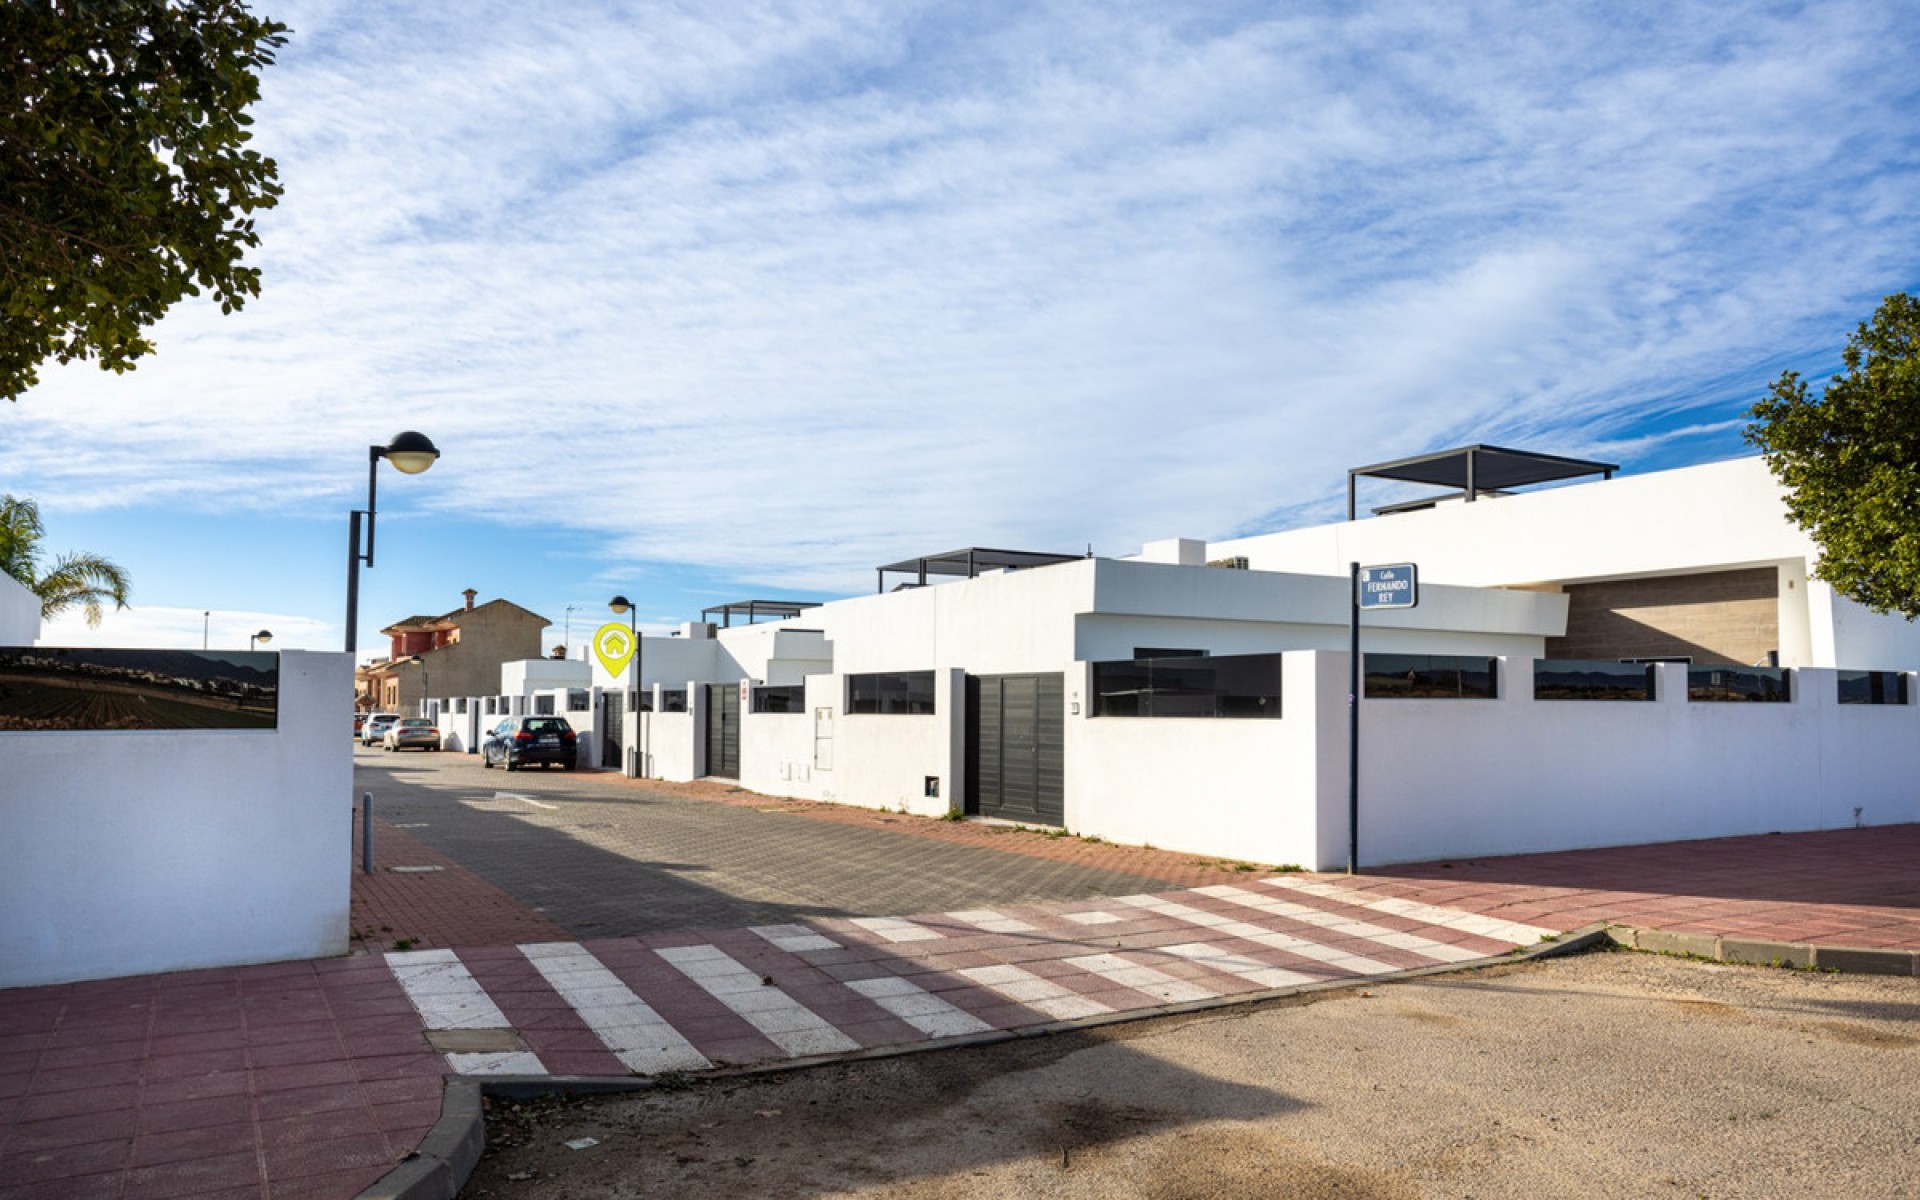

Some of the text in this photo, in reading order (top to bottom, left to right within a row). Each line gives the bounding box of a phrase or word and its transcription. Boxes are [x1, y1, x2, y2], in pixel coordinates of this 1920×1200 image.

[1380, 570, 1394, 580] Calle
[1368, 580, 1409, 593] FERNANDO
[1379, 593, 1393, 603] REY
